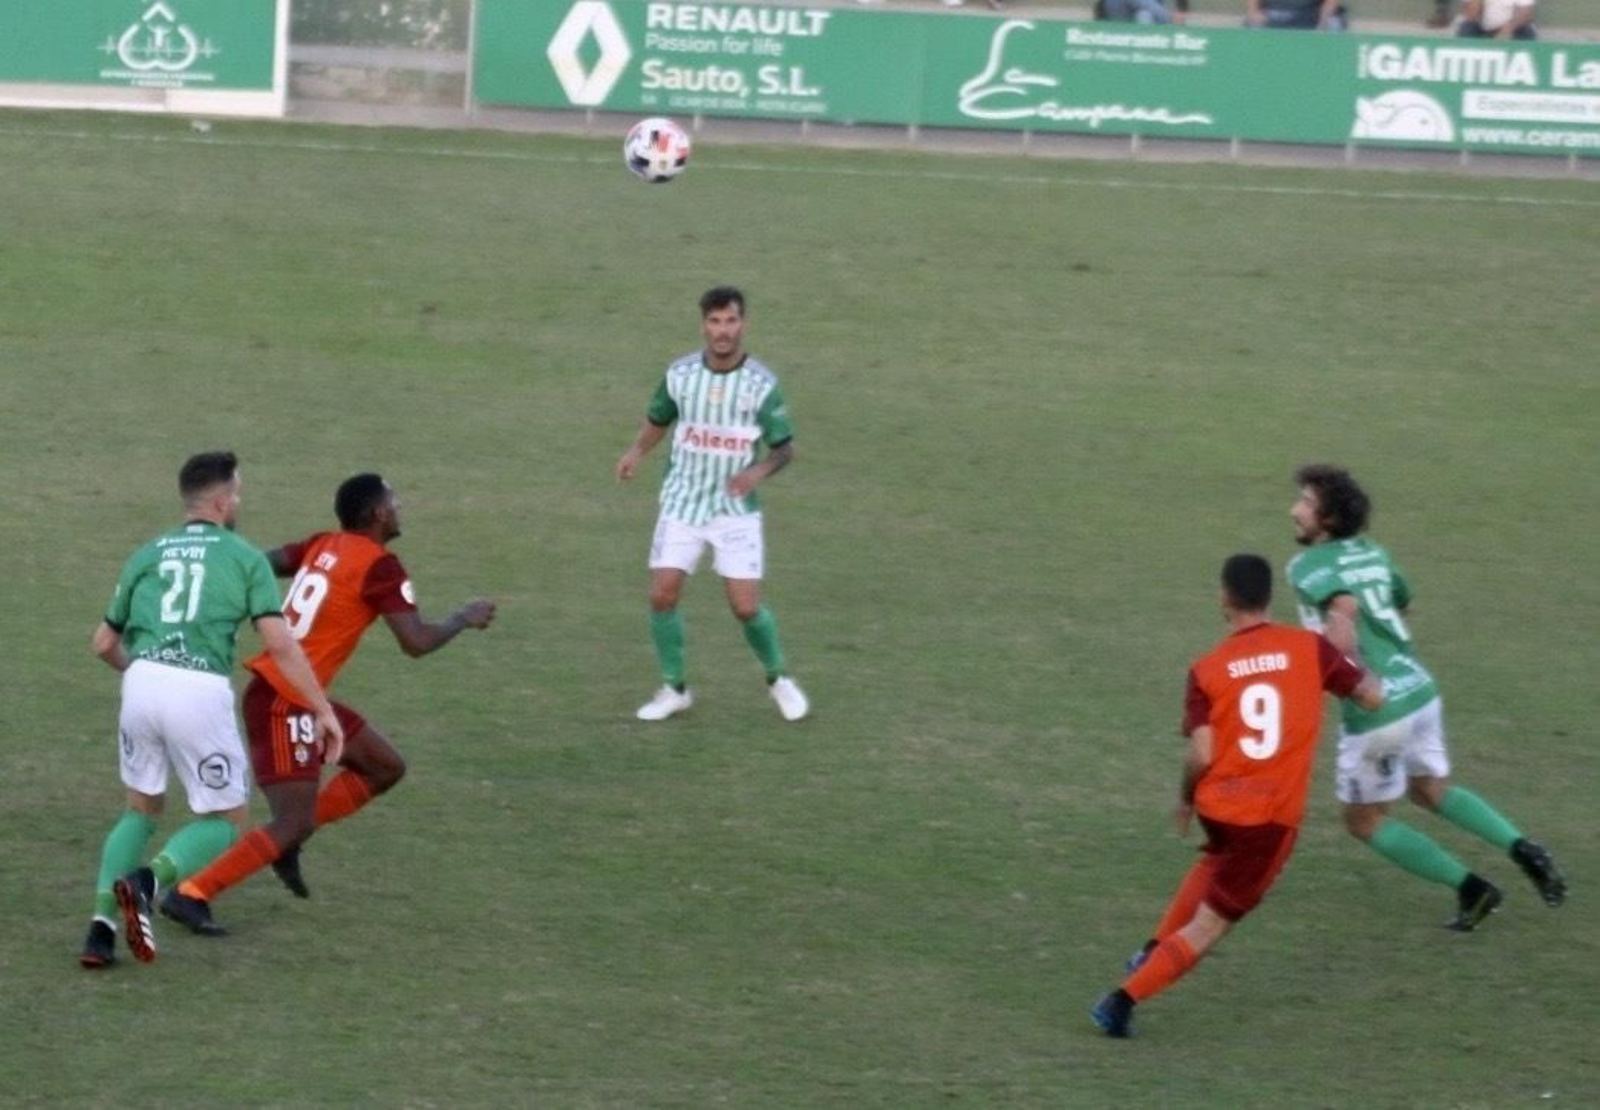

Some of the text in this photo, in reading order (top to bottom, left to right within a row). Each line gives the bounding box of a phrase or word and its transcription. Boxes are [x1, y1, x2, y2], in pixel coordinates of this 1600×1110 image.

[646, 3, 830, 37] RENAULT
[645, 32, 784, 56] Passion for life
[641, 59, 821, 98] Sauto, S.L.
[1368, 43, 1538, 86] GAMMA
[159, 559, 206, 624] 21
[1226, 653, 1289, 678] SILLERO
[287, 715, 315, 744] 19
[1238, 683, 1281, 760] 9
